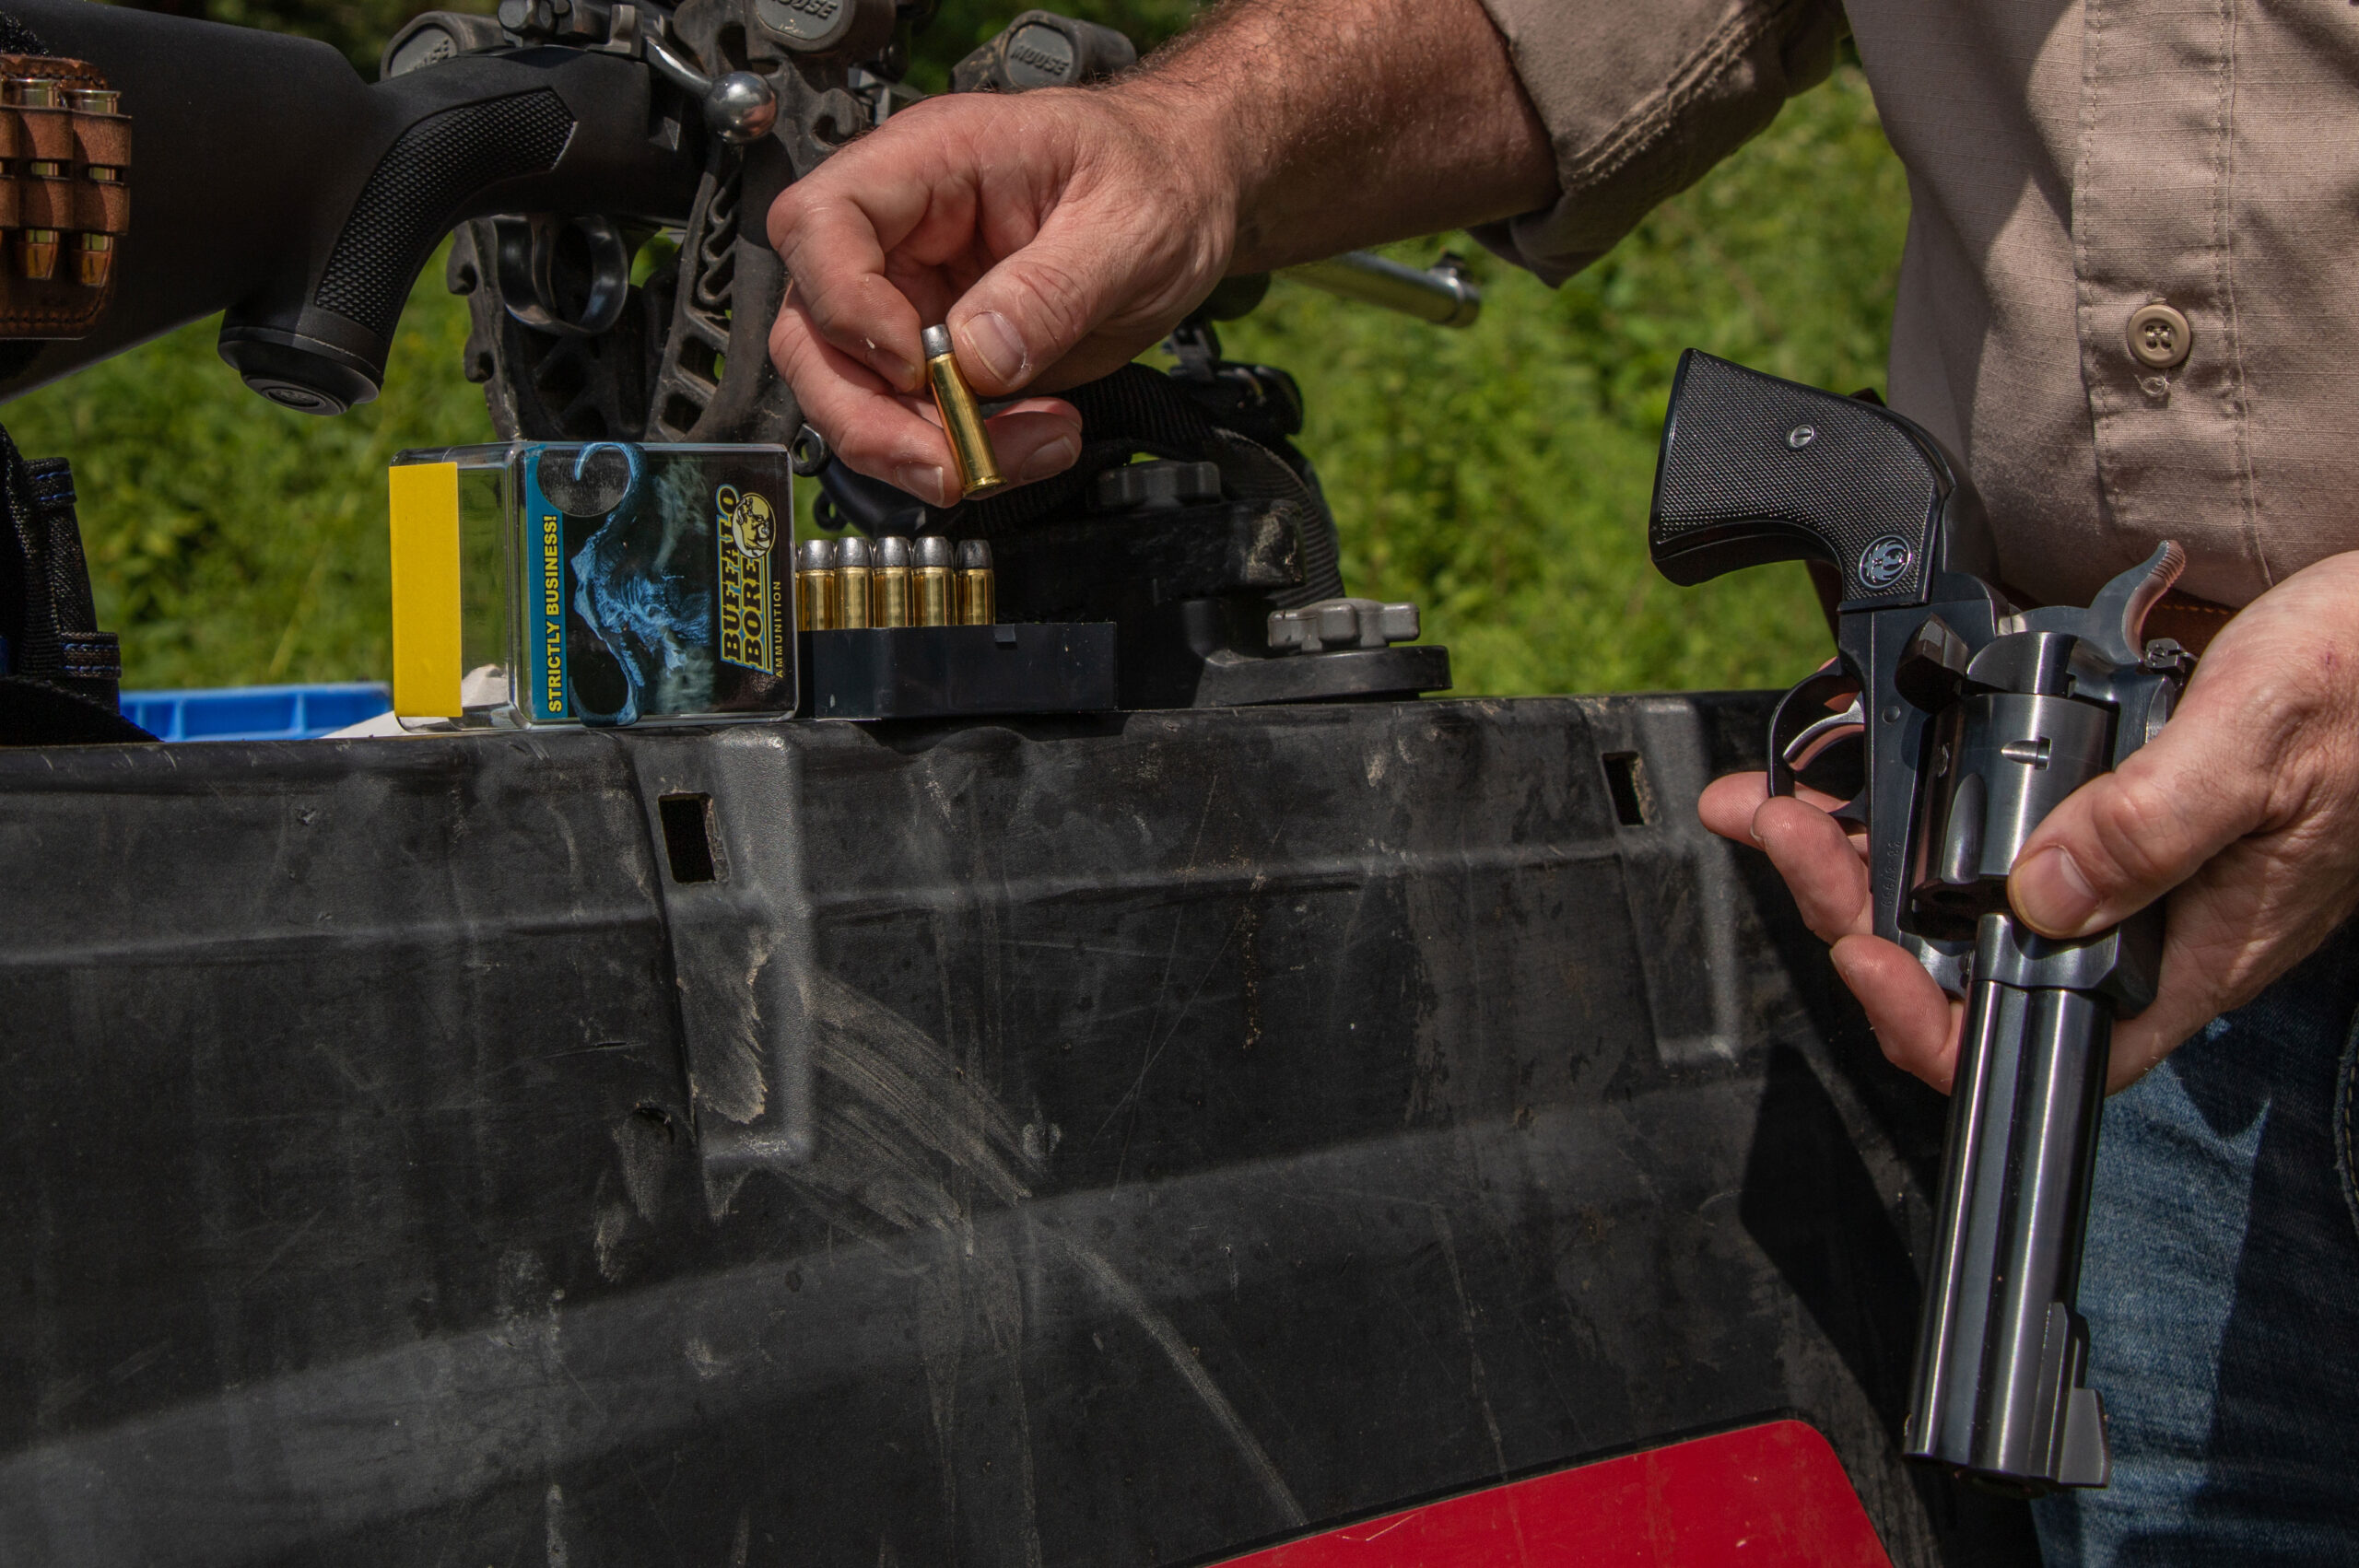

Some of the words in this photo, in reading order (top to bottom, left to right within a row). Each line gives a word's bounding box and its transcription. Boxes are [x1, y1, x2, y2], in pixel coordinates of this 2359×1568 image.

[1010, 44, 1070, 76] MOOSE
[543, 514, 560, 615] BUSINESS!
[718, 486, 742, 663] BUFFALO
[740, 554, 765, 671] BORE
[545, 620, 563, 713] STRICTLY
[772, 580, 784, 678] AMMUNITION
